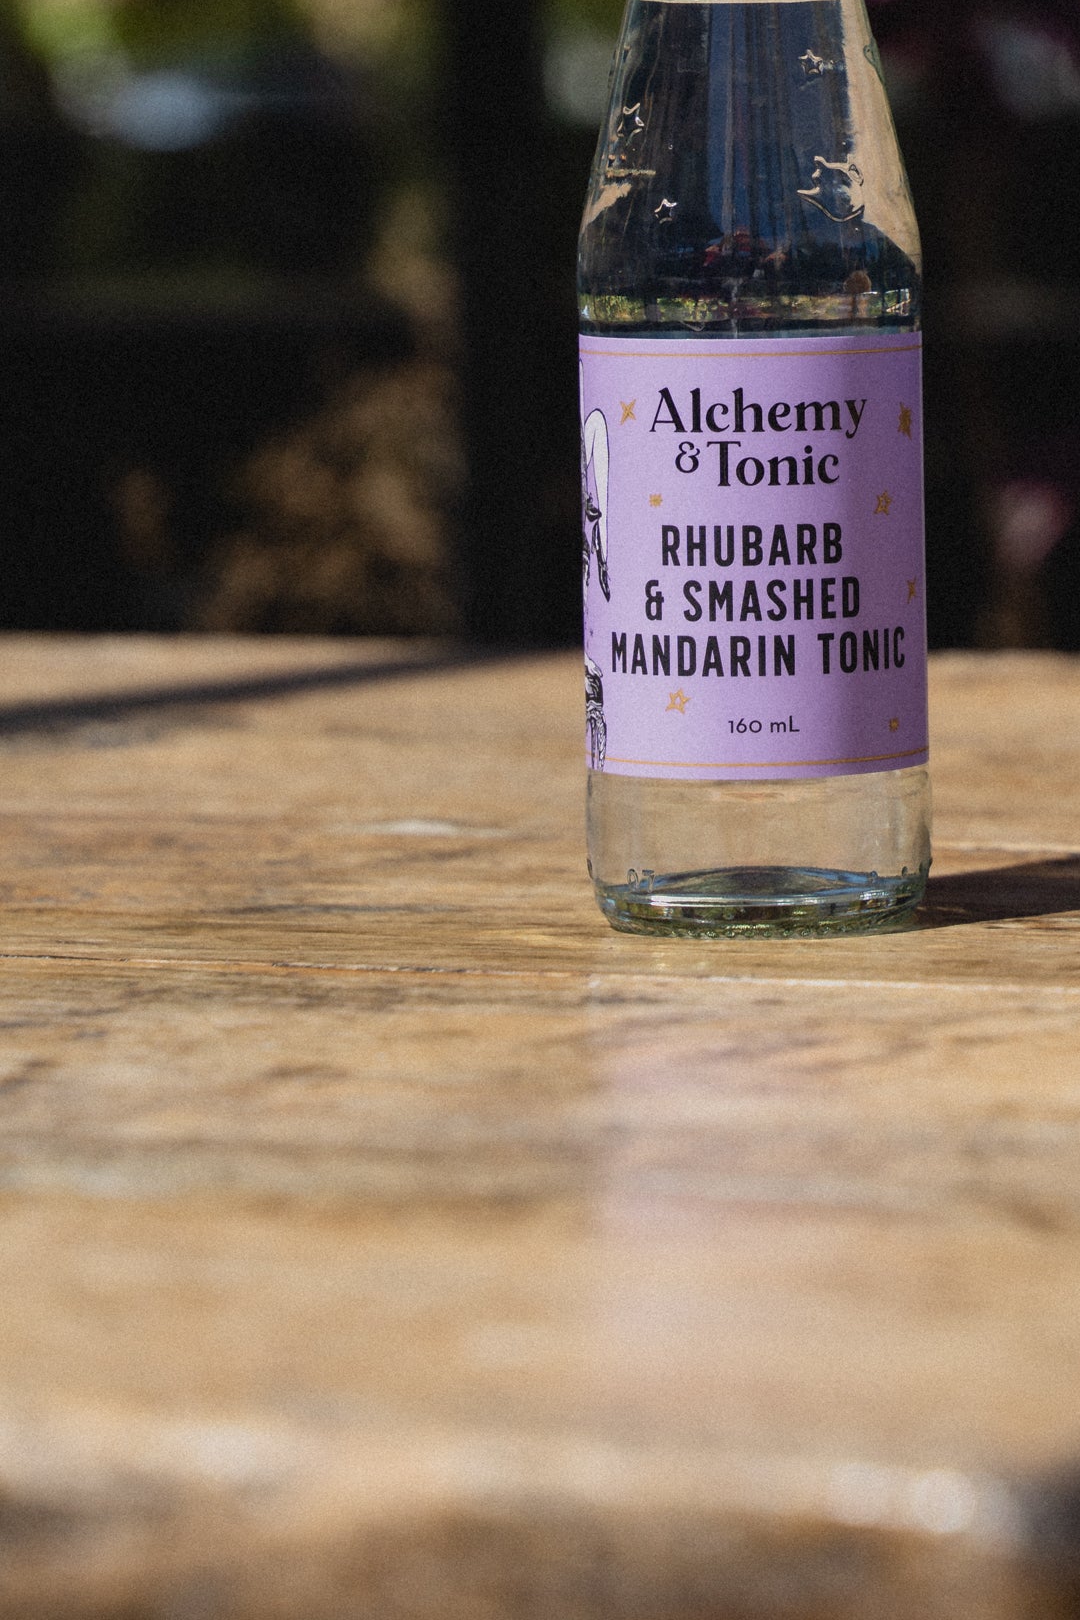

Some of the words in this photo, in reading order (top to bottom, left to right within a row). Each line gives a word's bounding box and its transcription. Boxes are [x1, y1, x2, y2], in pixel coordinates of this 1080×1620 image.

[649, 386, 868, 439] Alchemy
[660, 521, 845, 568] RHUBARB
[644, 578, 665, 622] &
[682, 576, 861, 623] SMASHED
[610, 630, 797, 678] MANDARIN
[816, 625, 907, 675] TONIC
[727, 717, 764, 735] 160
[769, 714, 801, 734] mL
